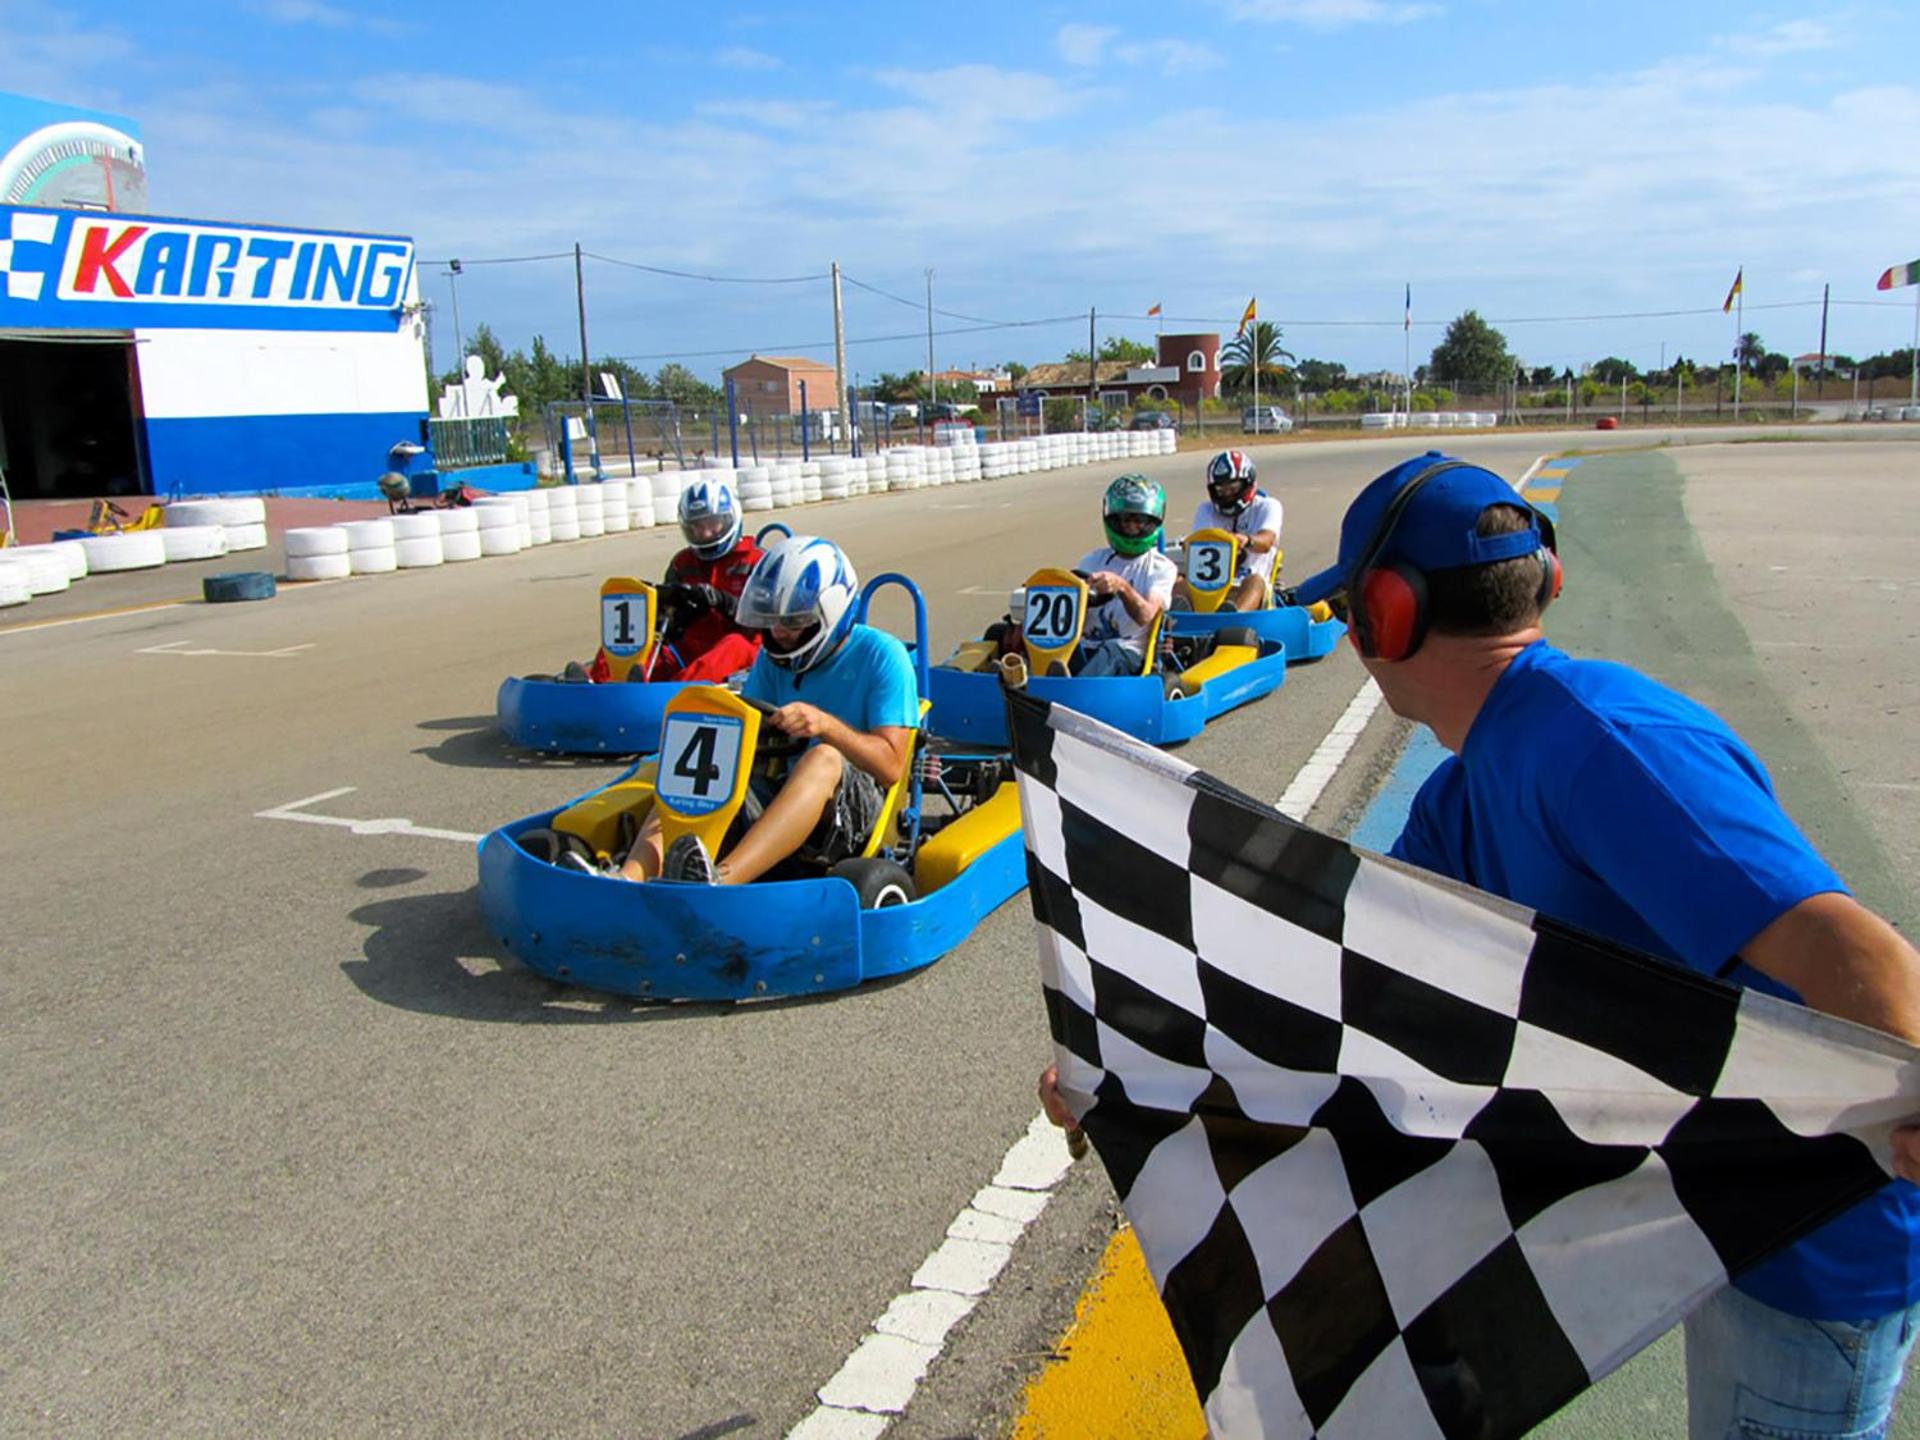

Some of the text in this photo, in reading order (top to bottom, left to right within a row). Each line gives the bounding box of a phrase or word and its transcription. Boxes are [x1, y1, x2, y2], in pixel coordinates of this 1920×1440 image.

[73, 226, 407, 306] KARTING
[1196, 547, 1221, 581] 3
[613, 601, 635, 644] 1
[1027, 593, 1074, 637] 20
[673, 726, 719, 796] 4
